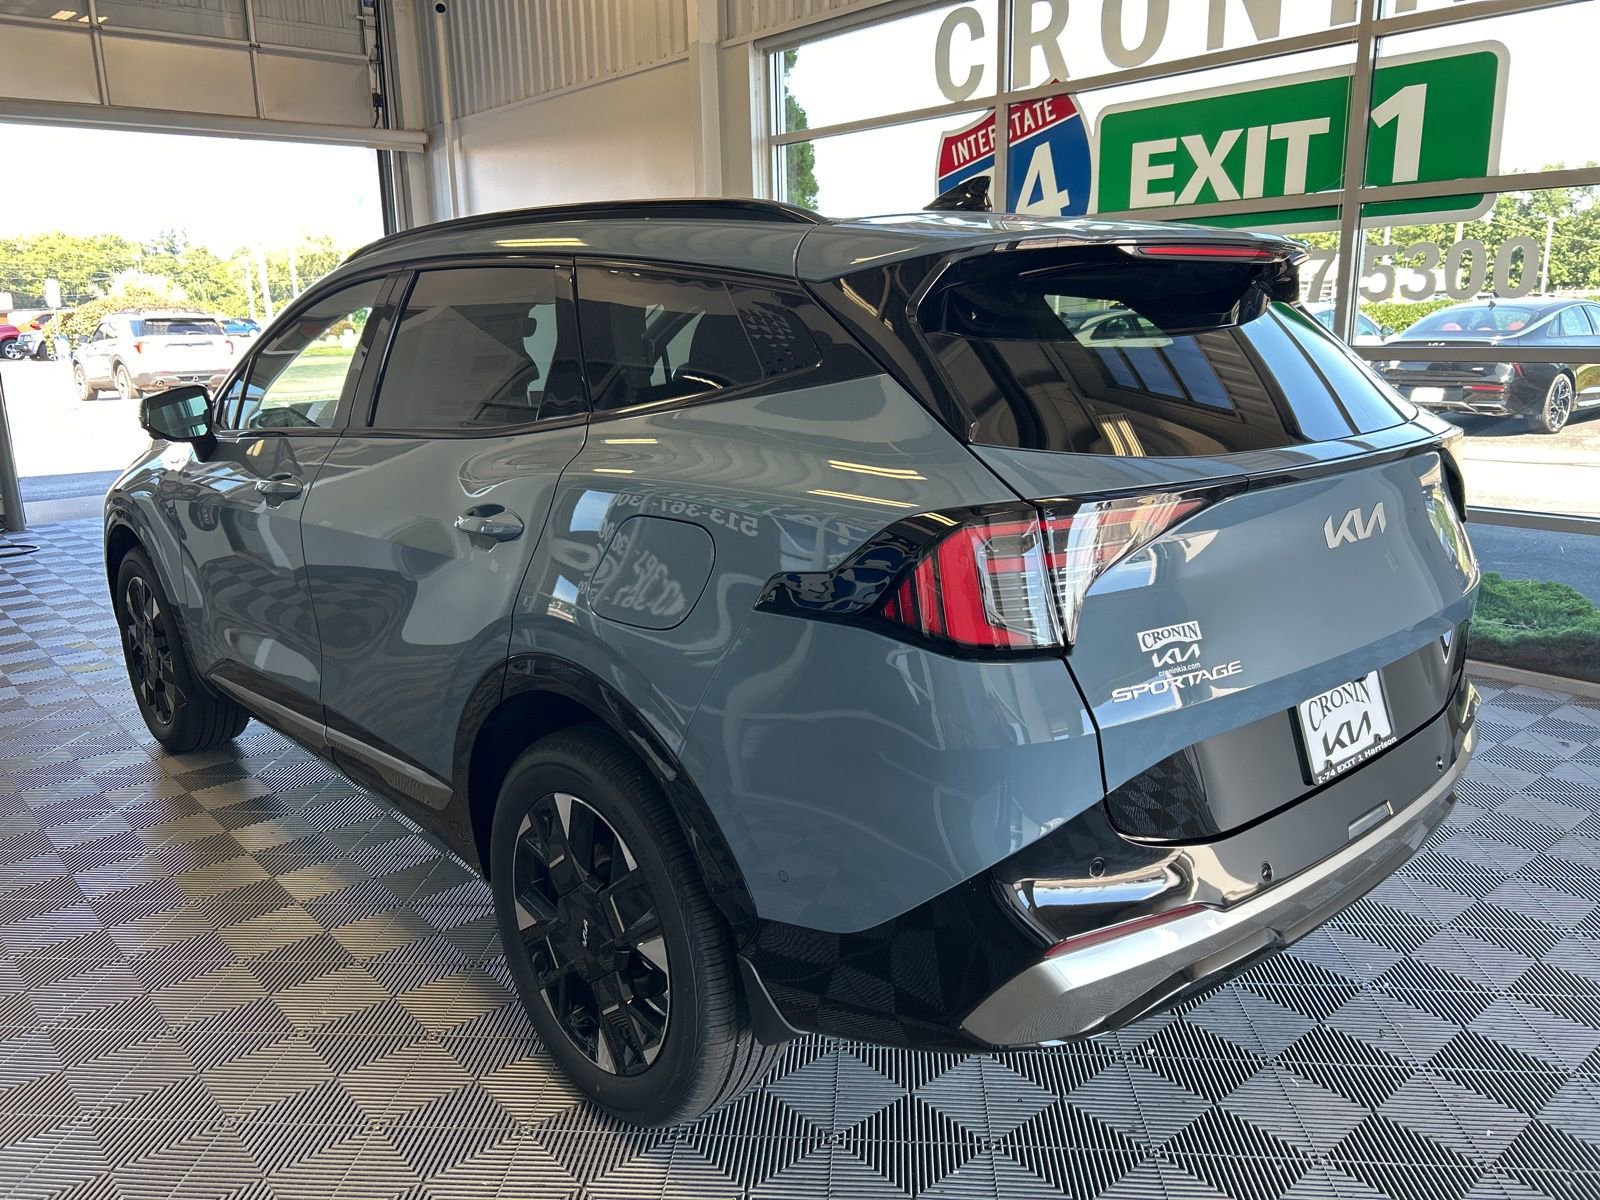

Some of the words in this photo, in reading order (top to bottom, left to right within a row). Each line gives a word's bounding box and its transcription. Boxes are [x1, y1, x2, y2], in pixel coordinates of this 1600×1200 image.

[951, 97, 1057, 167] INTERTATE
[1129, 116, 1330, 210] EXIT
[1370, 83, 1428, 184] 1
[1323, 501, 1387, 550] KIA
[1141, 622, 1199, 650] CRONIN
[1151, 643, 1201, 668] KIA
[1111, 660, 1243, 703] SPORTAGE
[1308, 681, 1372, 732] CRONIN
[1322, 710, 1372, 758] KIA
[1318, 769, 1336, 784] I-74
[1337, 758, 1356, 773] EXIT
[1364, 736, 1397, 758] Harrison
